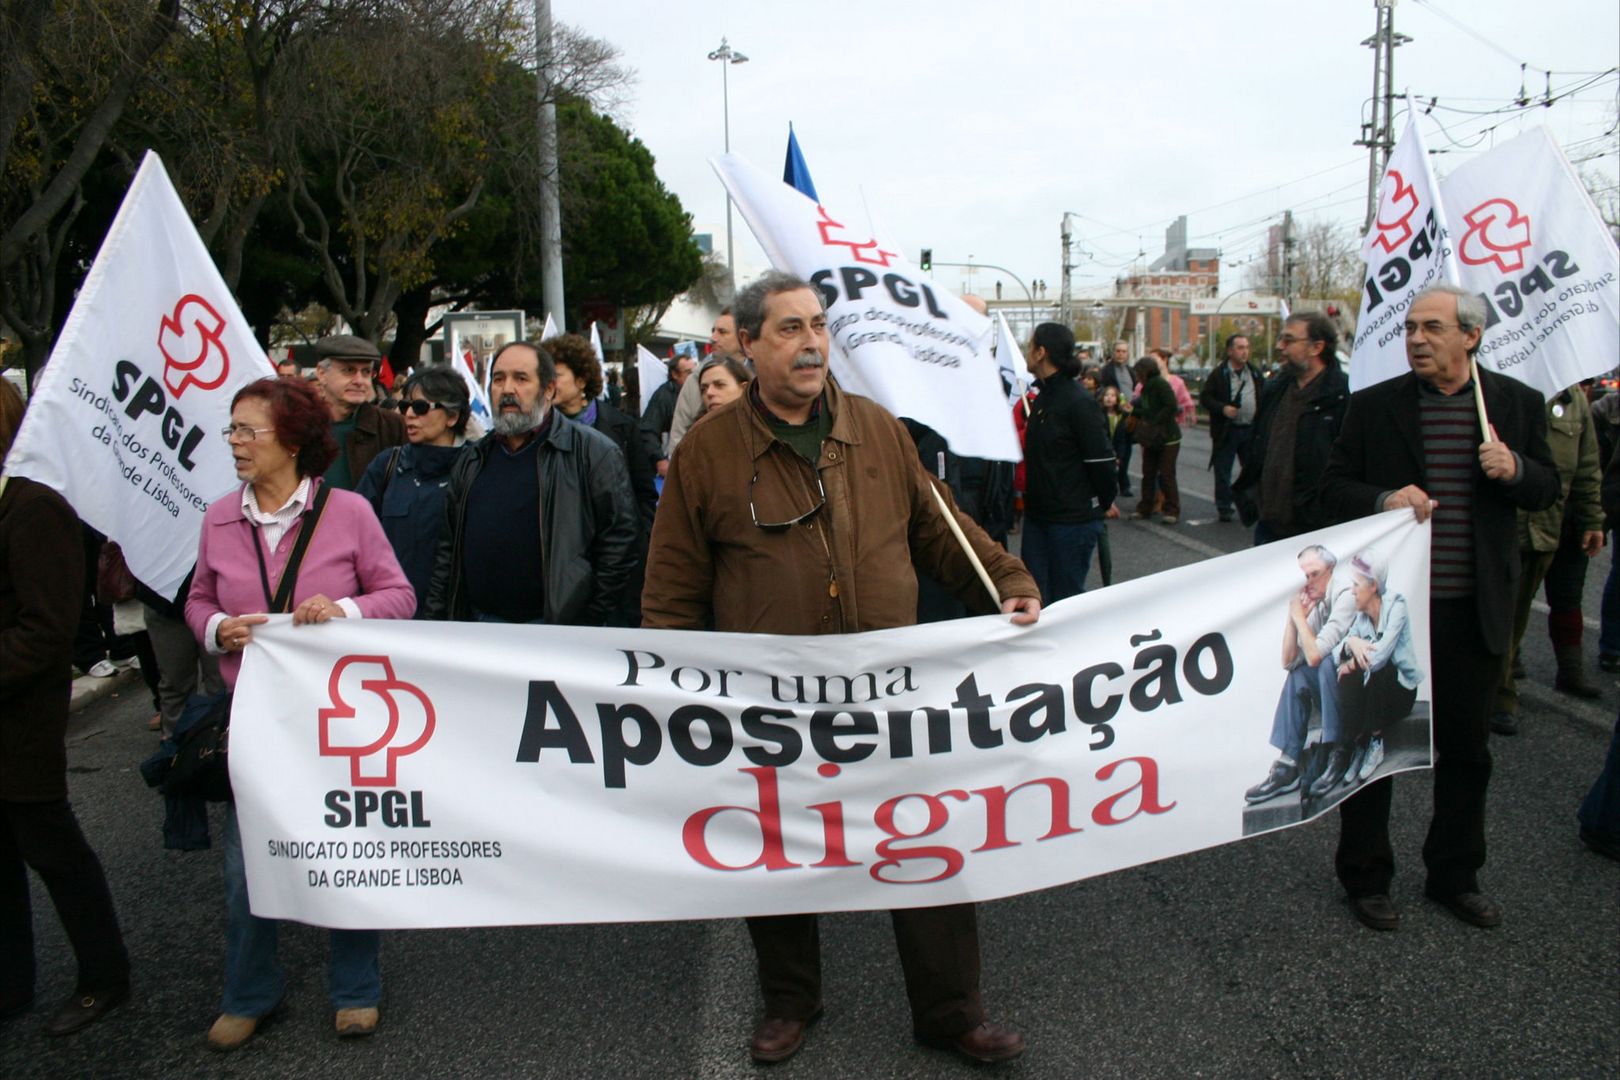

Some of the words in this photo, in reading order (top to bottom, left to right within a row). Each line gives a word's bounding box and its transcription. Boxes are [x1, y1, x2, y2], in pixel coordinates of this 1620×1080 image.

[810, 266, 949, 320] SPGL
[112, 360, 206, 473] SPGL
[92, 425, 112, 446] da
[143, 478, 181, 518] Lisboa
[122, 432, 150, 459] dos
[149, 451, 211, 513] Professores
[515, 629, 1235, 788] Aposentação
[615, 648, 743, 699] Por
[769, 663, 920, 704] uma
[324, 789, 432, 828] SPGL
[681, 754, 1178, 884] digna
[268, 839, 348, 860] SINDICATO
[352, 841, 385, 859] DOS
[390, 840, 502, 859] PROFESSORES
[308, 870, 329, 888] DA
[333, 868, 401, 888] GRANDE
[406, 867, 463, 886] LISBOA
